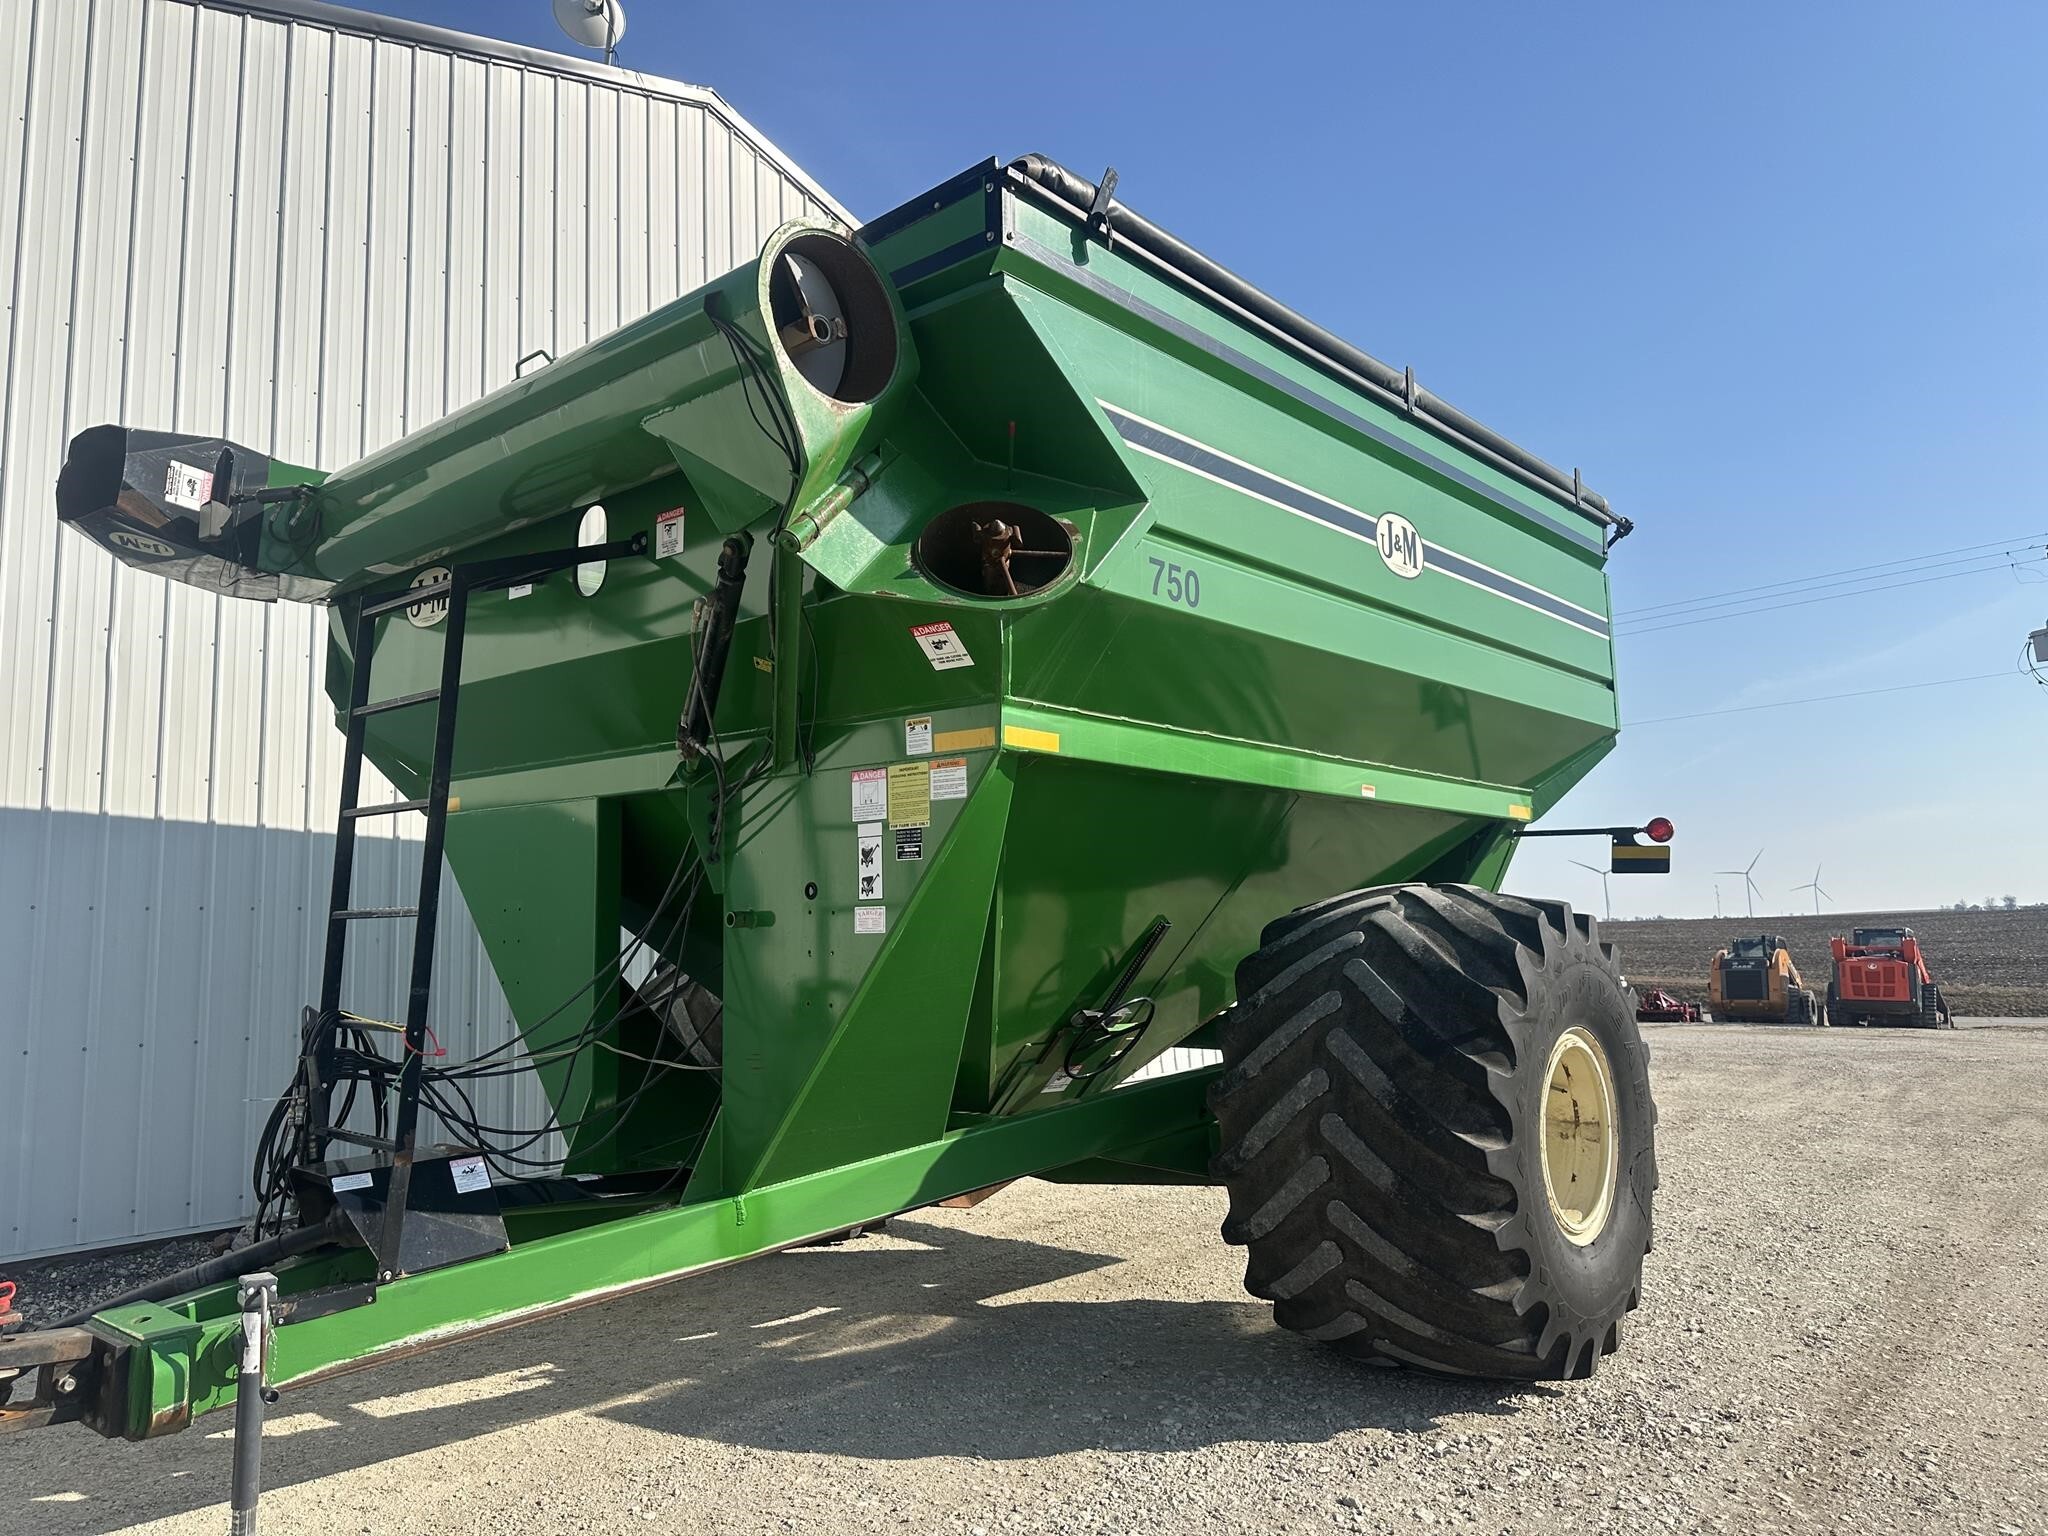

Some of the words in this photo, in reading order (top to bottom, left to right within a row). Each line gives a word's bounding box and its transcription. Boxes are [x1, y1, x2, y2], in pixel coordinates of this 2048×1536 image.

[1380, 519, 1418, 570] J&M
[1149, 557, 1200, 608] 750
[919, 623, 952, 635] DANGER
[860, 769, 886, 780] DANGER
